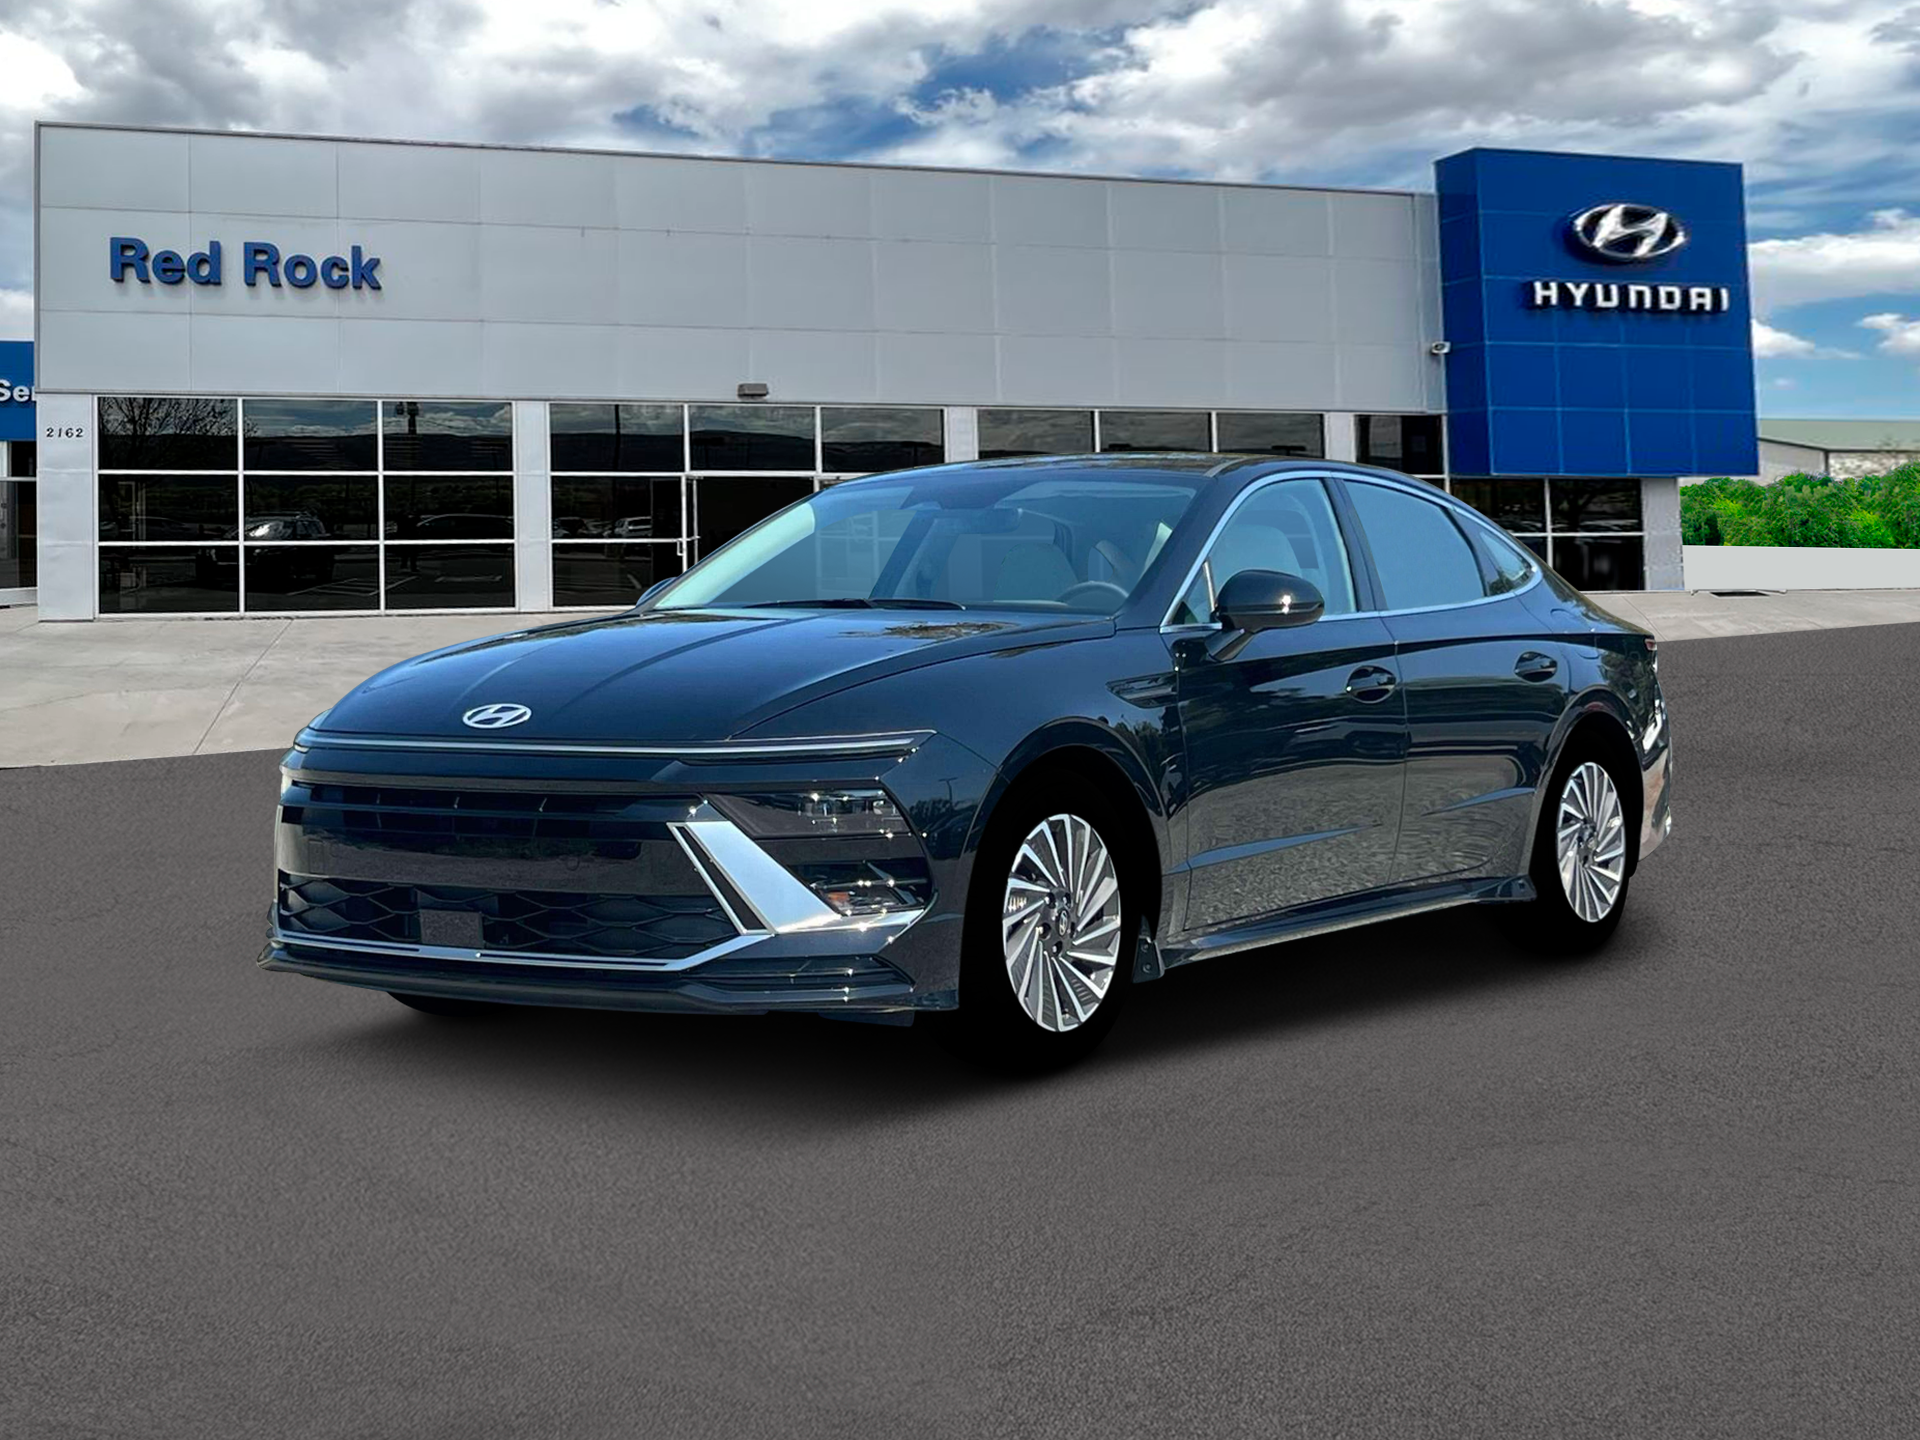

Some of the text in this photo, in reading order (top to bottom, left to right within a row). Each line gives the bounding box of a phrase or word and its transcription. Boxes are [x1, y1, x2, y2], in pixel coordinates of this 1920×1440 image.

[110, 237, 382, 290] Red Rock
[1533, 281, 1730, 312] HYUNDAI
[46, 427, 83, 438] 2162
